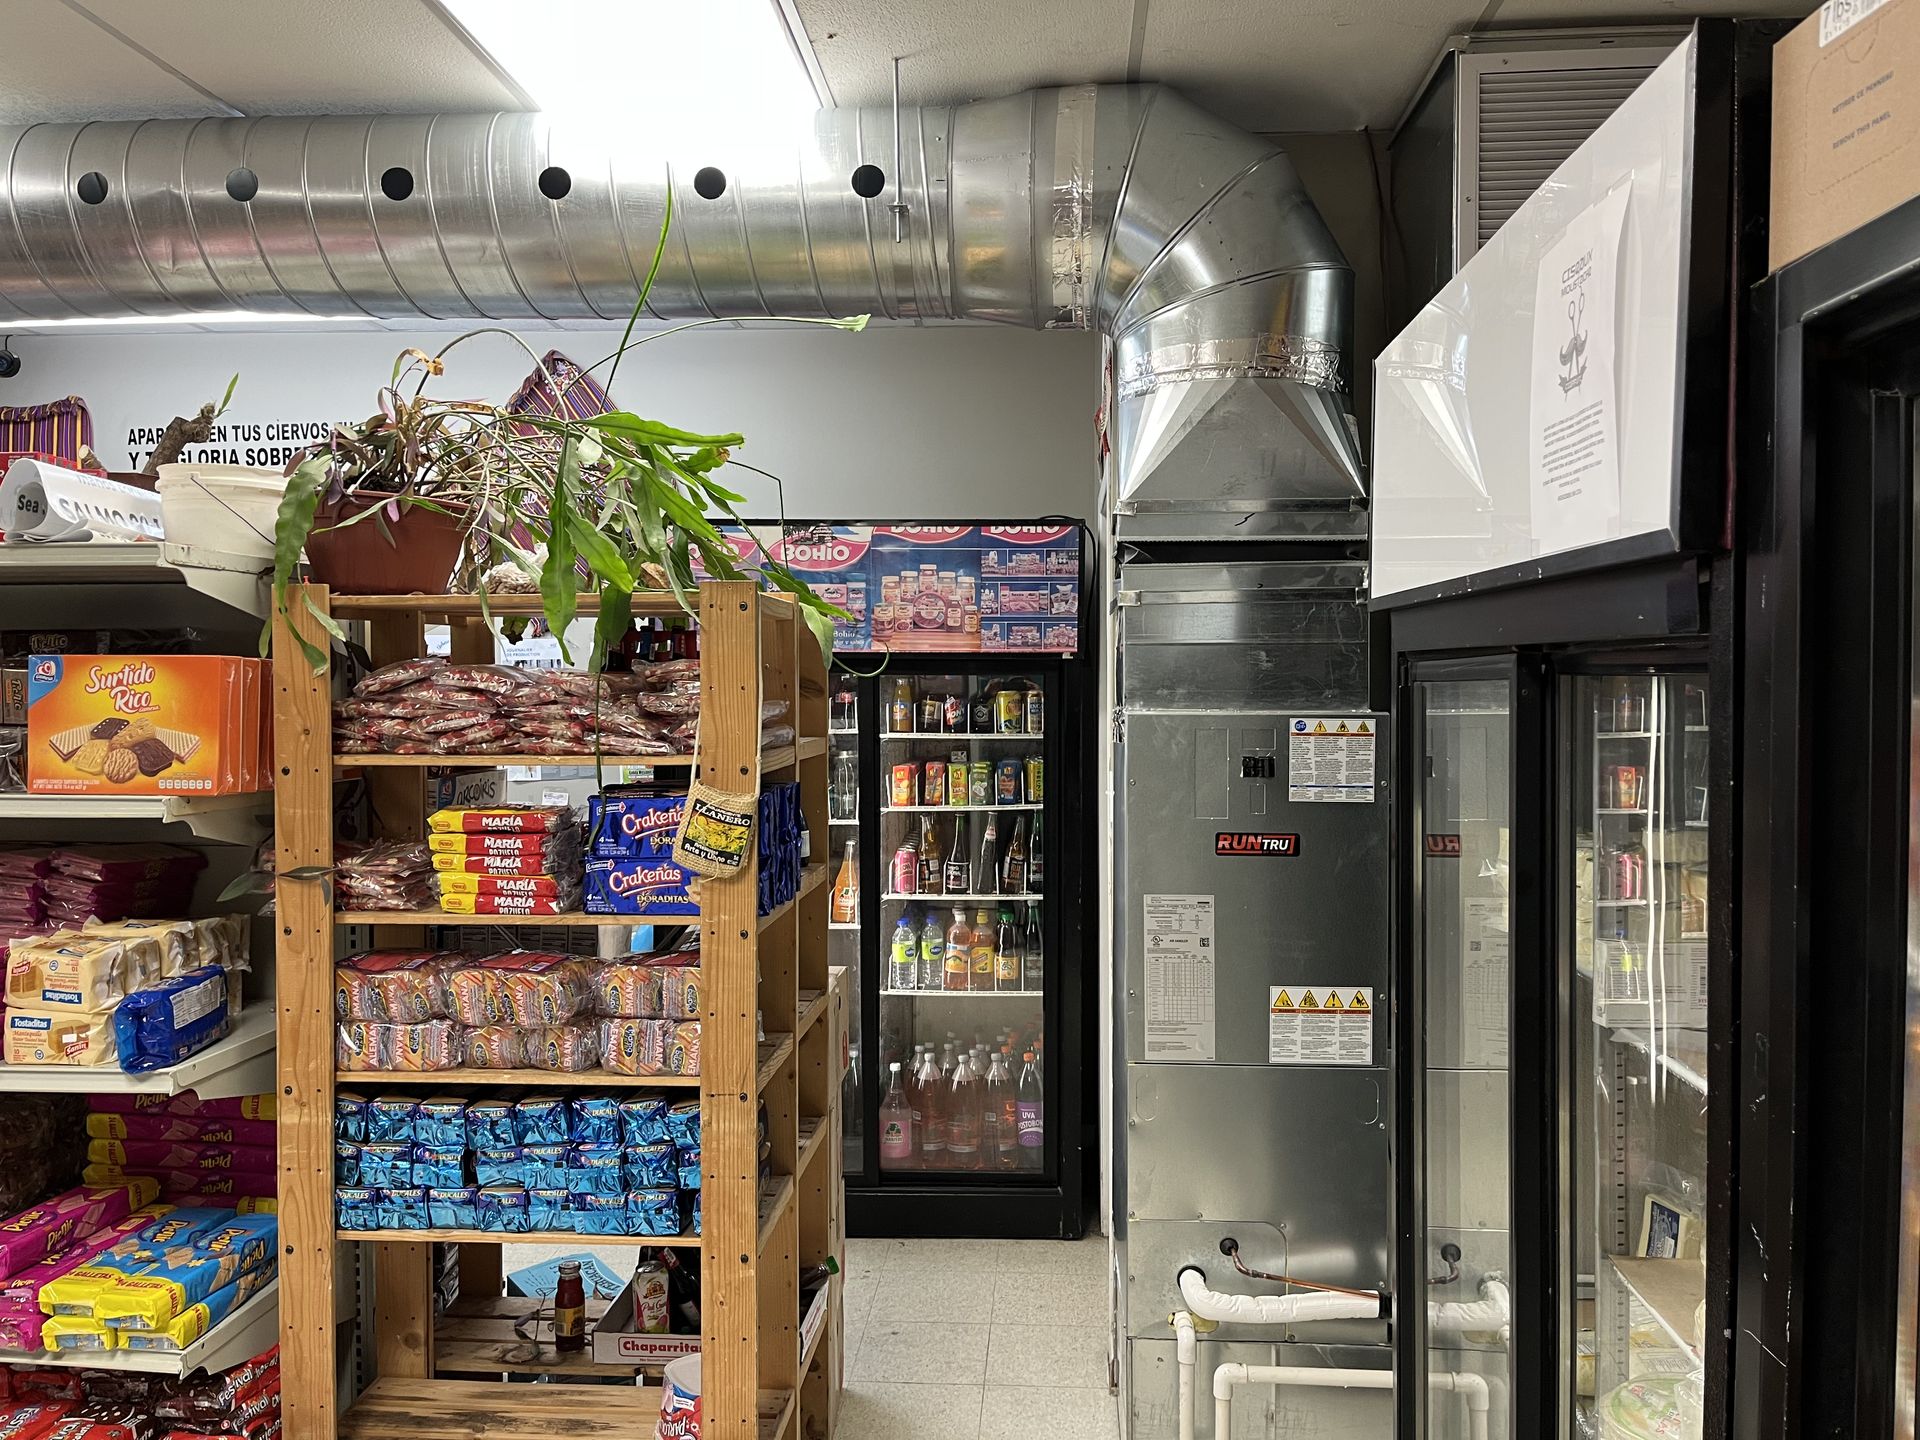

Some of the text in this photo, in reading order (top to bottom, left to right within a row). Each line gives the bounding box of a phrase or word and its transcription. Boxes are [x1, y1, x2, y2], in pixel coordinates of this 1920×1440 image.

[1832, 111, 1892, 149] REMOVE THIS PANEL
[233, 425, 261, 441] TUS
[129, 451, 140, 470] Y
[18, 494, 39, 513] Sea
[86, 662, 155, 693] Surtido
[110, 686, 151, 713] Rico
[482, 815, 523, 827] MARÍA
[622, 804, 685, 834] Crakeña
[484, 837, 523, 849] MARÍA
[684, 843, 700, 855] Arte
[483, 856, 522, 868] MARÍA
[497, 880, 537, 891] MARÍA
[609, 863, 682, 892] Crakeñas
[494, 896, 536, 908] MARÍA
[637, 895, 689, 904] DORADITAS
[45, 991, 78, 1002] Tostaditas
[350, 980, 361, 1018] EMANA
[388, 983, 399, 1024] LEMANA
[460, 980, 471, 1024] LEMANA
[515, 984, 527, 1026] LEMANA
[624, 977, 635, 1017] LEMANA
[14, 1018, 47, 1028] Tostaditas
[688, 1039, 700, 1075] EMANA
[338, 1103, 356, 1111] ALES
[1022, 1111, 1036, 1119] UVA
[200, 1154, 232, 1168] Picnic
[48, 1219, 73, 1251] Picnic
[76, 1271, 113, 1279] GALLETAS
[218, 1368, 254, 1405] Festival
[233, 1396, 269, 1431] Festival
